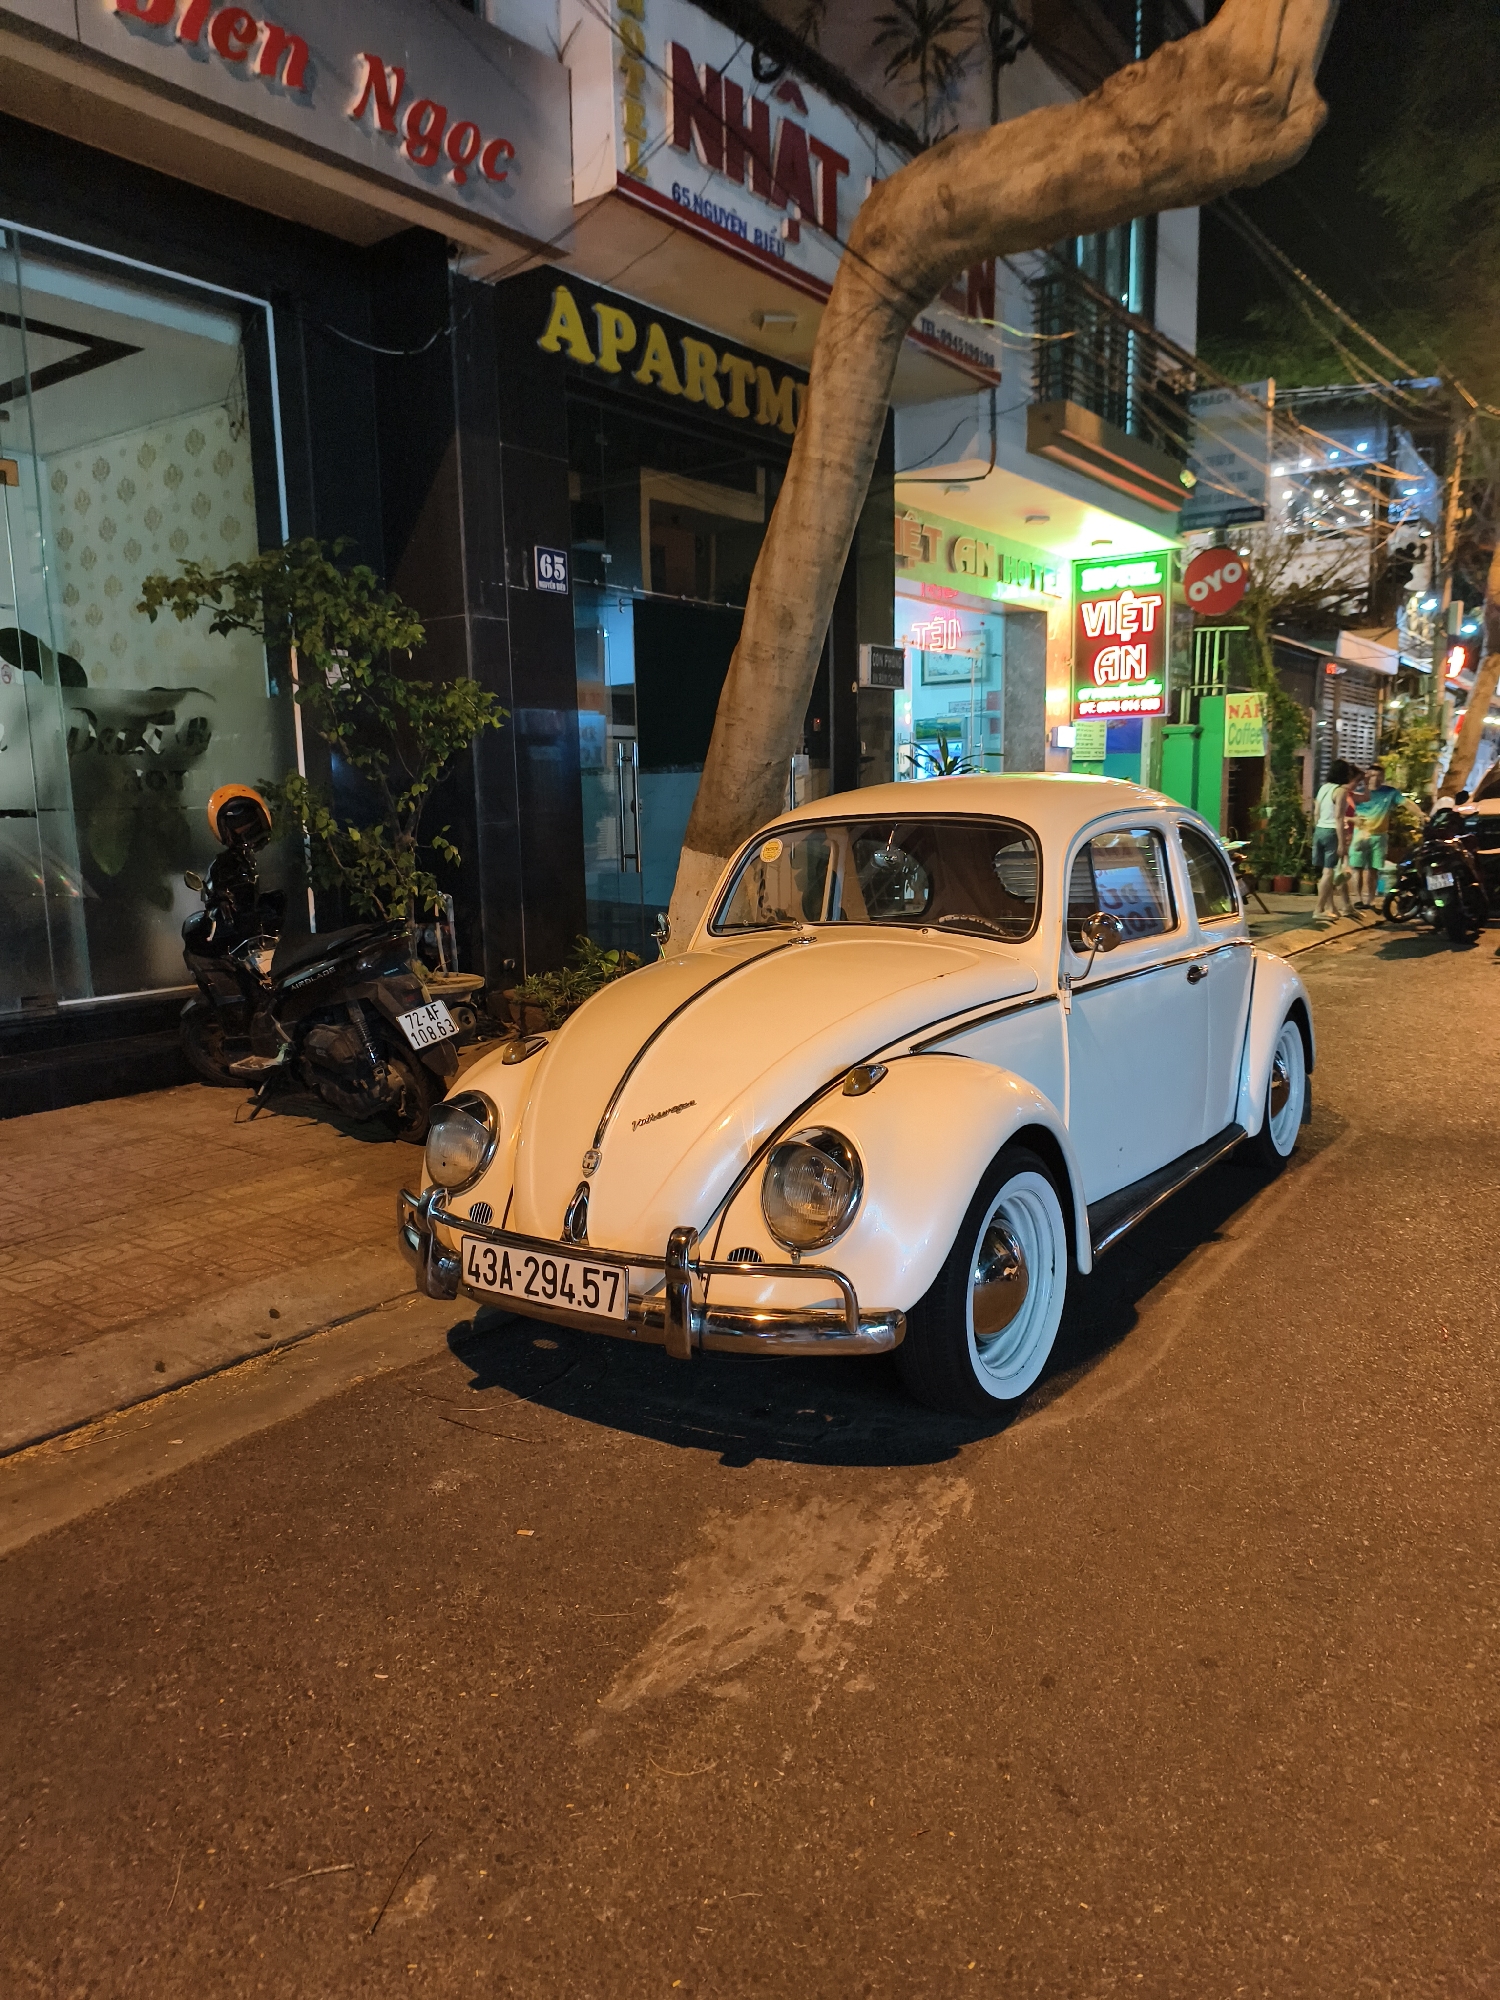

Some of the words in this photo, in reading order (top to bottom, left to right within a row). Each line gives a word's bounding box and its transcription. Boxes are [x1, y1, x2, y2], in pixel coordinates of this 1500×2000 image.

[112, 0, 309, 89] ien
[346, 52, 516, 185] Ngọc
[665, 40, 850, 244] NHẬT
[537, 285, 811, 435] APARTM
[540, 554, 566, 581] 65
[895, 510, 943, 569] IỆT
[953, 536, 996, 580] AN
[1003, 556, 1063, 599] HOTE
[1188, 562, 1243, 601] OYO
[1081, 590, 1162, 642] VIỆT
[1093, 643, 1147, 686] AN
[1228, 722, 1263, 746] Coffee
[405, 1004, 439, 1030] 72-AF
[411, 1019, 455, 1047] 108.63
[467, 1244, 620, 1313] 43A-294.57
